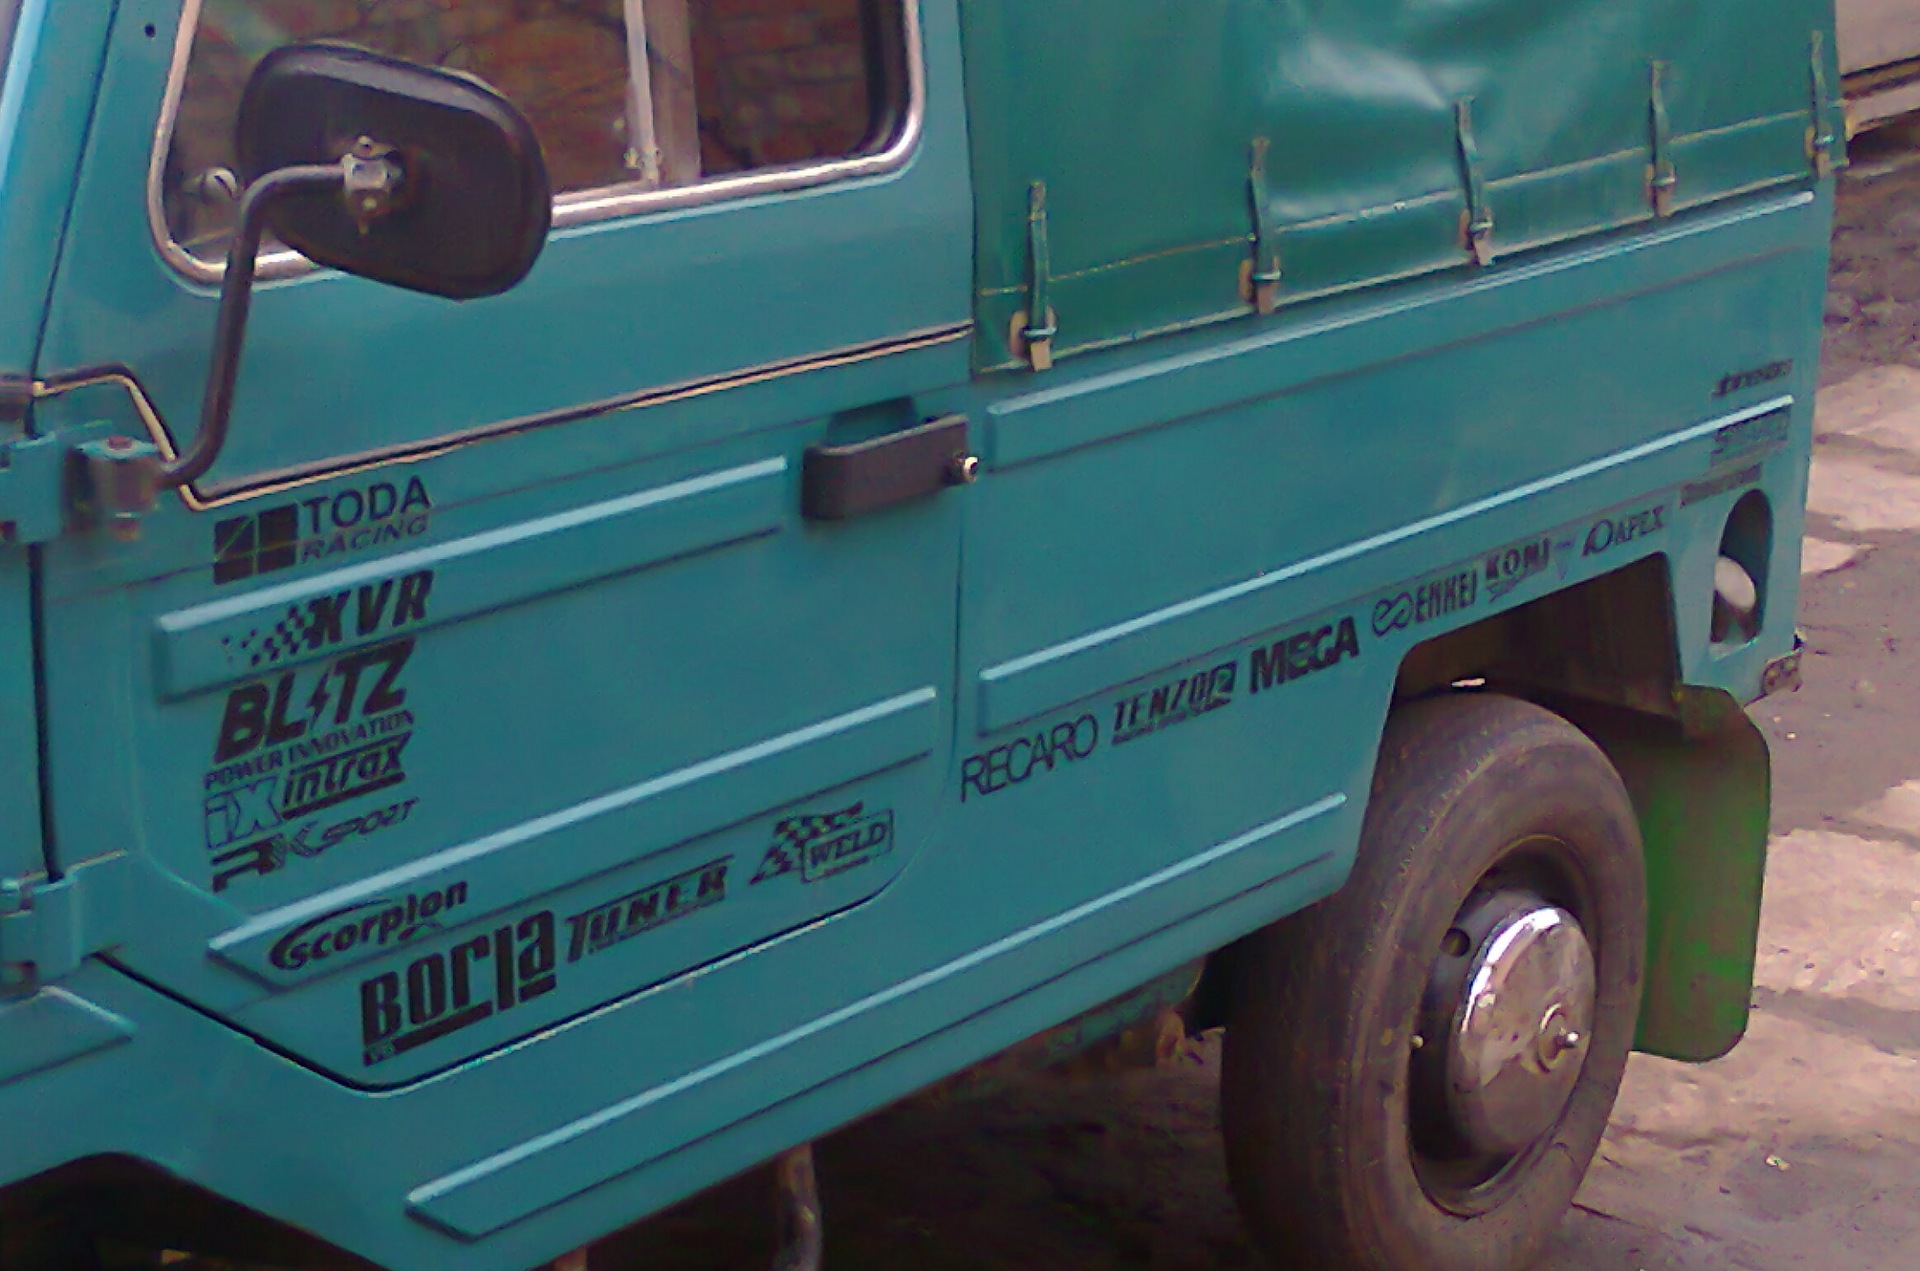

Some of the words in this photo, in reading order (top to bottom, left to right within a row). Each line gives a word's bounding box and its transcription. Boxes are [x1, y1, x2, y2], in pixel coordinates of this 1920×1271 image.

[303, 475, 431, 534] TODA
[302, 515, 428, 564] RACING
[213, 638, 416, 764] BLITZ
[203, 750, 284, 791] POWER
[960, 714, 1099, 803] RECARO
[809, 822, 888, 869] WELD
